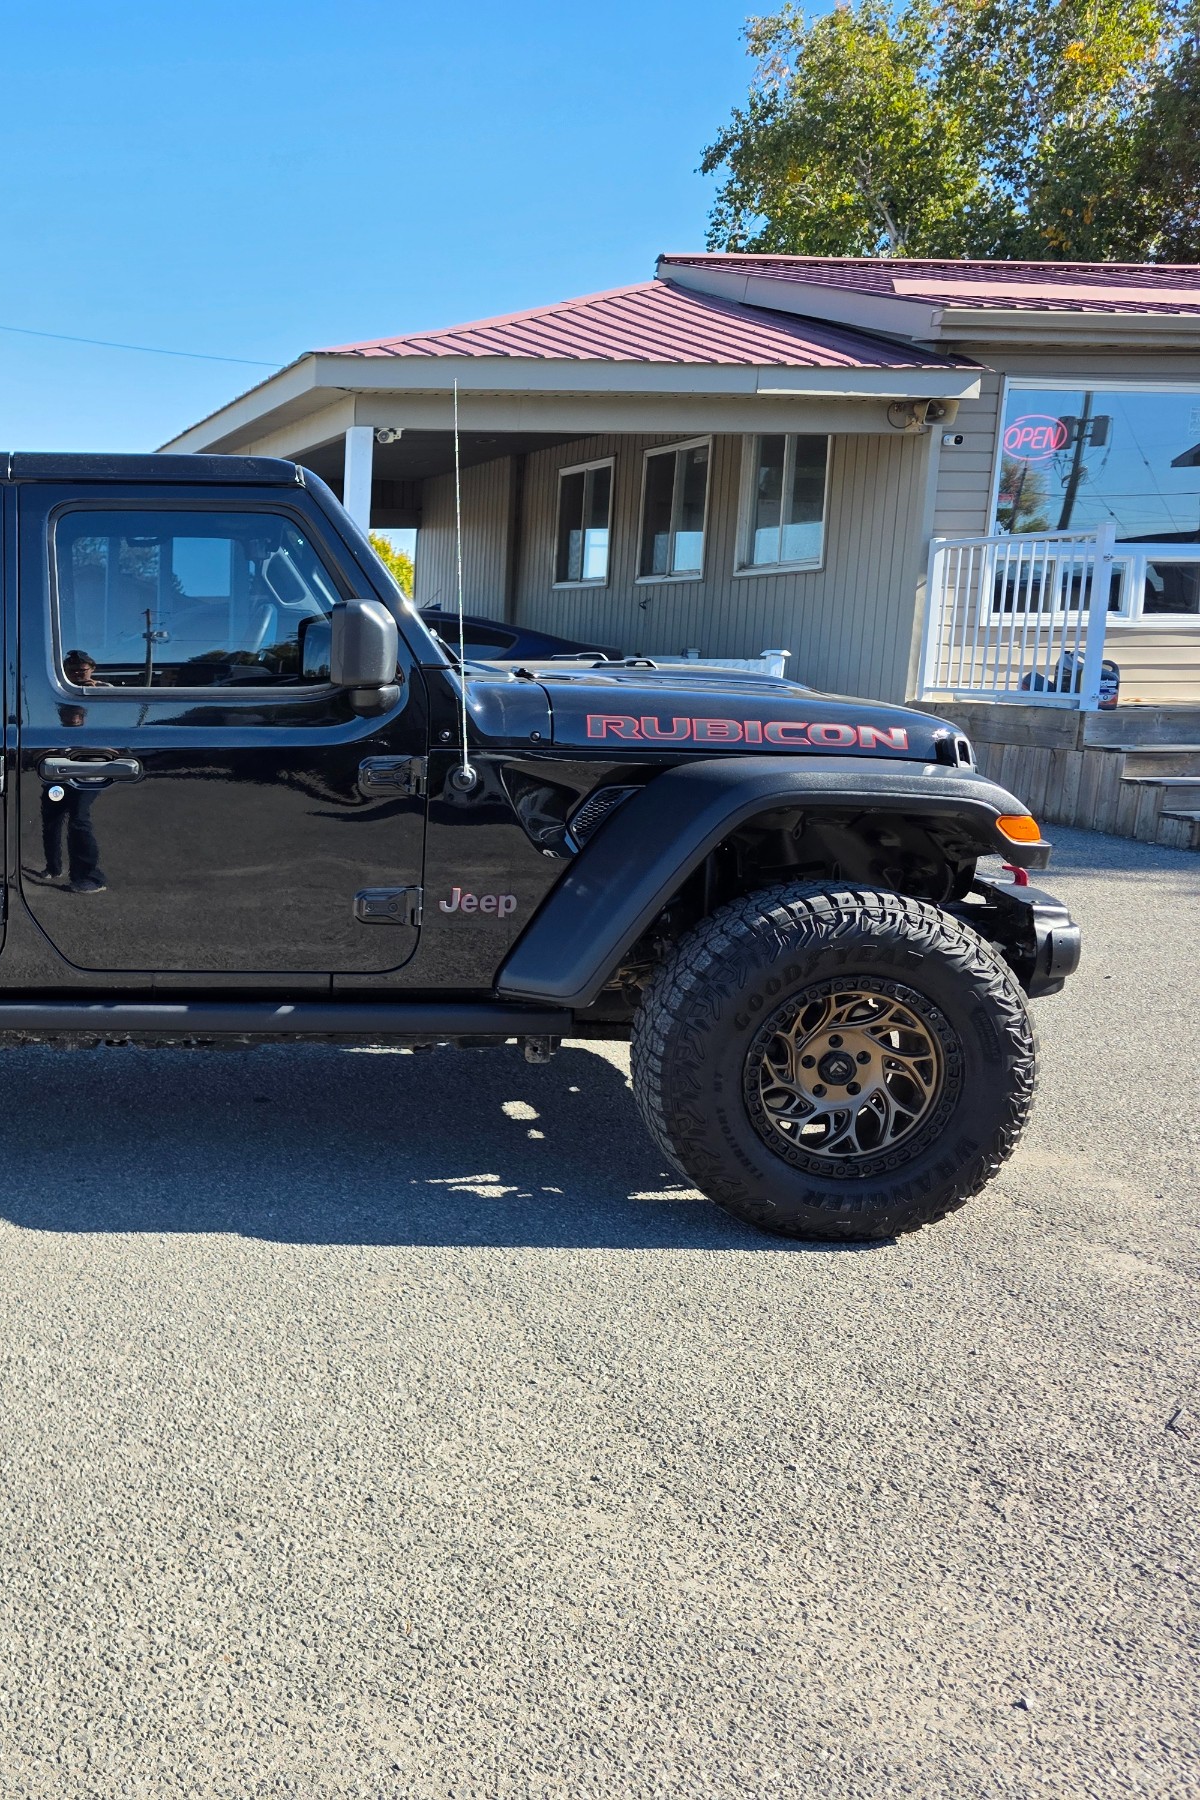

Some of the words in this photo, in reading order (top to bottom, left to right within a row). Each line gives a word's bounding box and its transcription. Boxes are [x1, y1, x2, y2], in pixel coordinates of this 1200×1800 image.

[1004, 426, 1062, 449] OPEN
[586, 714, 909, 750] RUBICON
[439, 888, 518, 917] Jeep
[802, 1136, 979, 1212] WRANGLER
